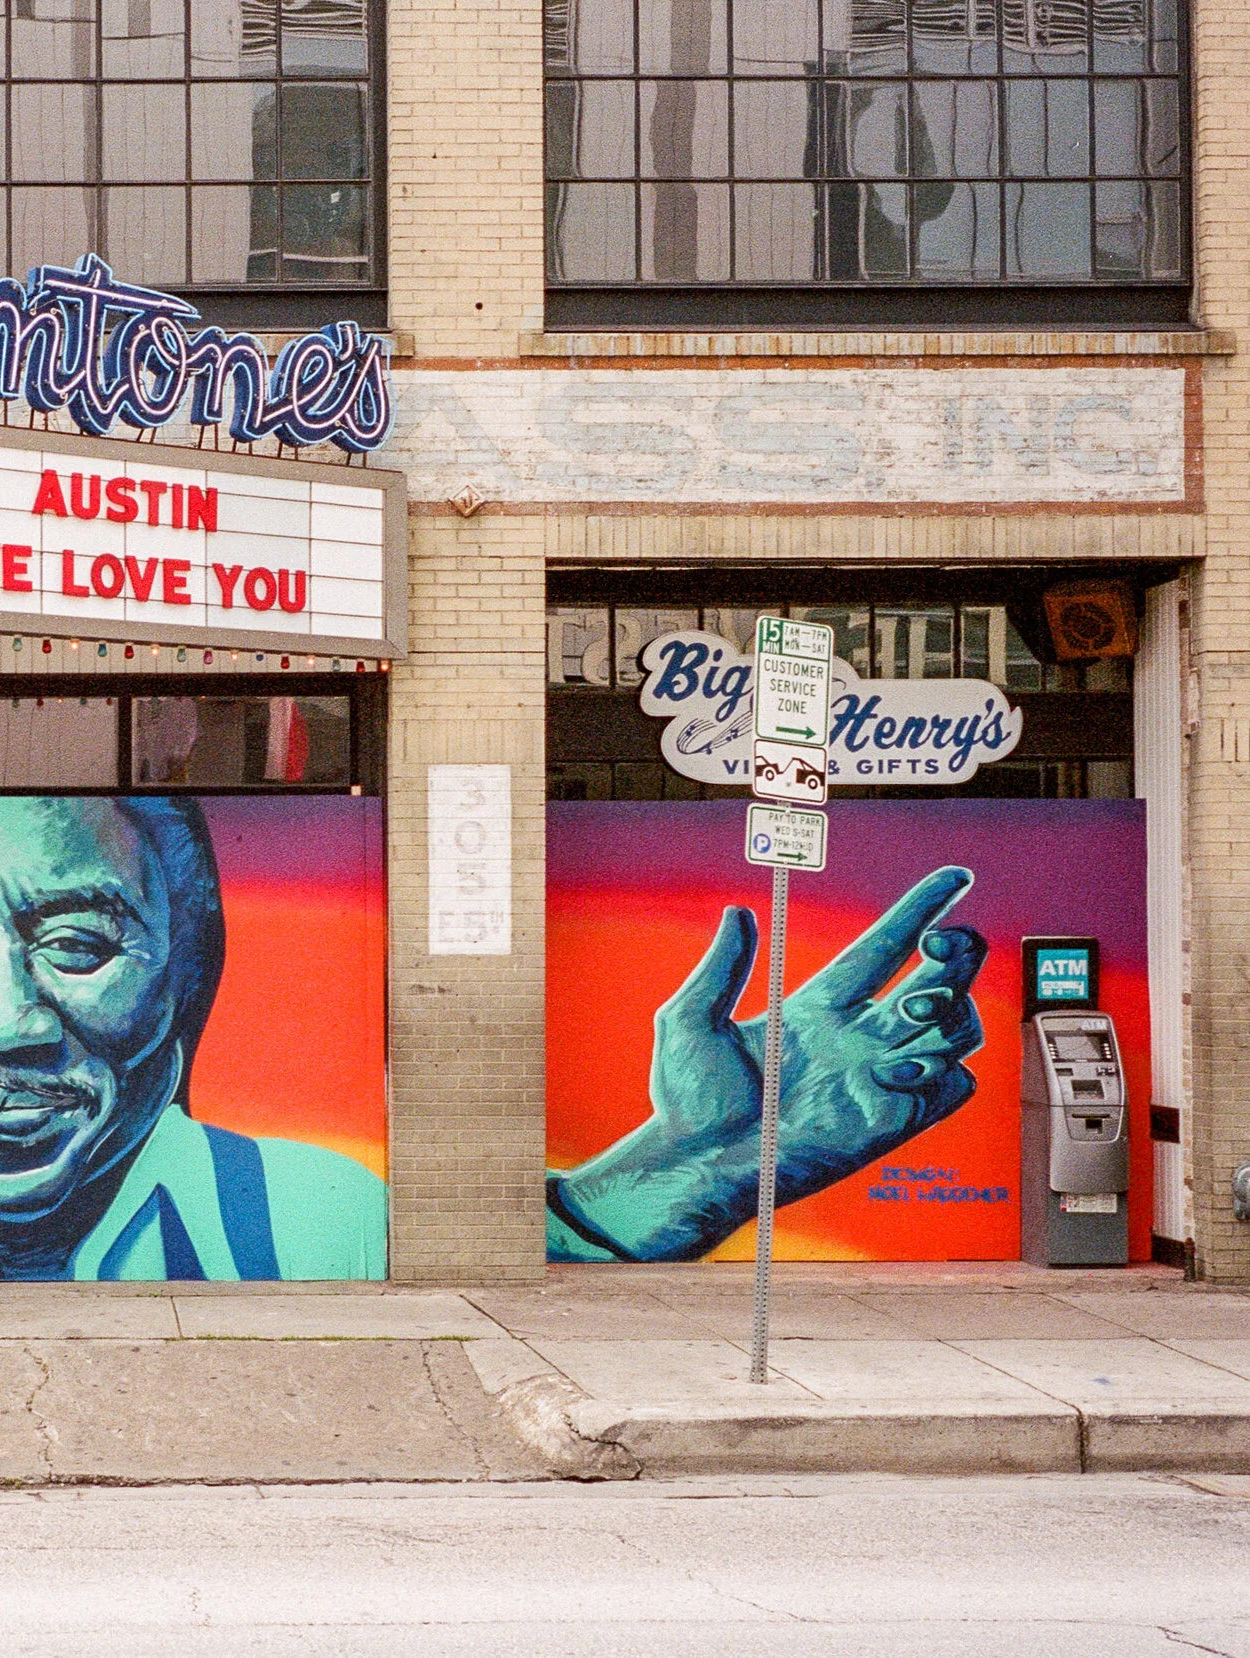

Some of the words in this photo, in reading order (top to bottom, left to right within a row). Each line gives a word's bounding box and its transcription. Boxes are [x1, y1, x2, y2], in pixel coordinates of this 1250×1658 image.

[32, 469, 218, 532] AUSTIN
[62, 550, 191, 605] LOVE
[212, 563, 306, 613] YOU
[762, 619, 781, 642] 15
[762, 641, 780, 654] MIN
[764, 658, 824, 680] CUSTOMER
[769, 678, 817, 697] SERVICE
[653, 640, 753, 722] Big
[829, 693, 1012, 773] Henry's
[777, 698, 807, 715] ZONE
[857, 759, 939, 775] GIFTS
[768, 812, 784, 822] PAY
[785, 813, 797, 824] TO
[800, 816, 821, 826] PARK
[1039, 959, 1087, 976] ATM
[1081, 1021, 1108, 1031] ATM
